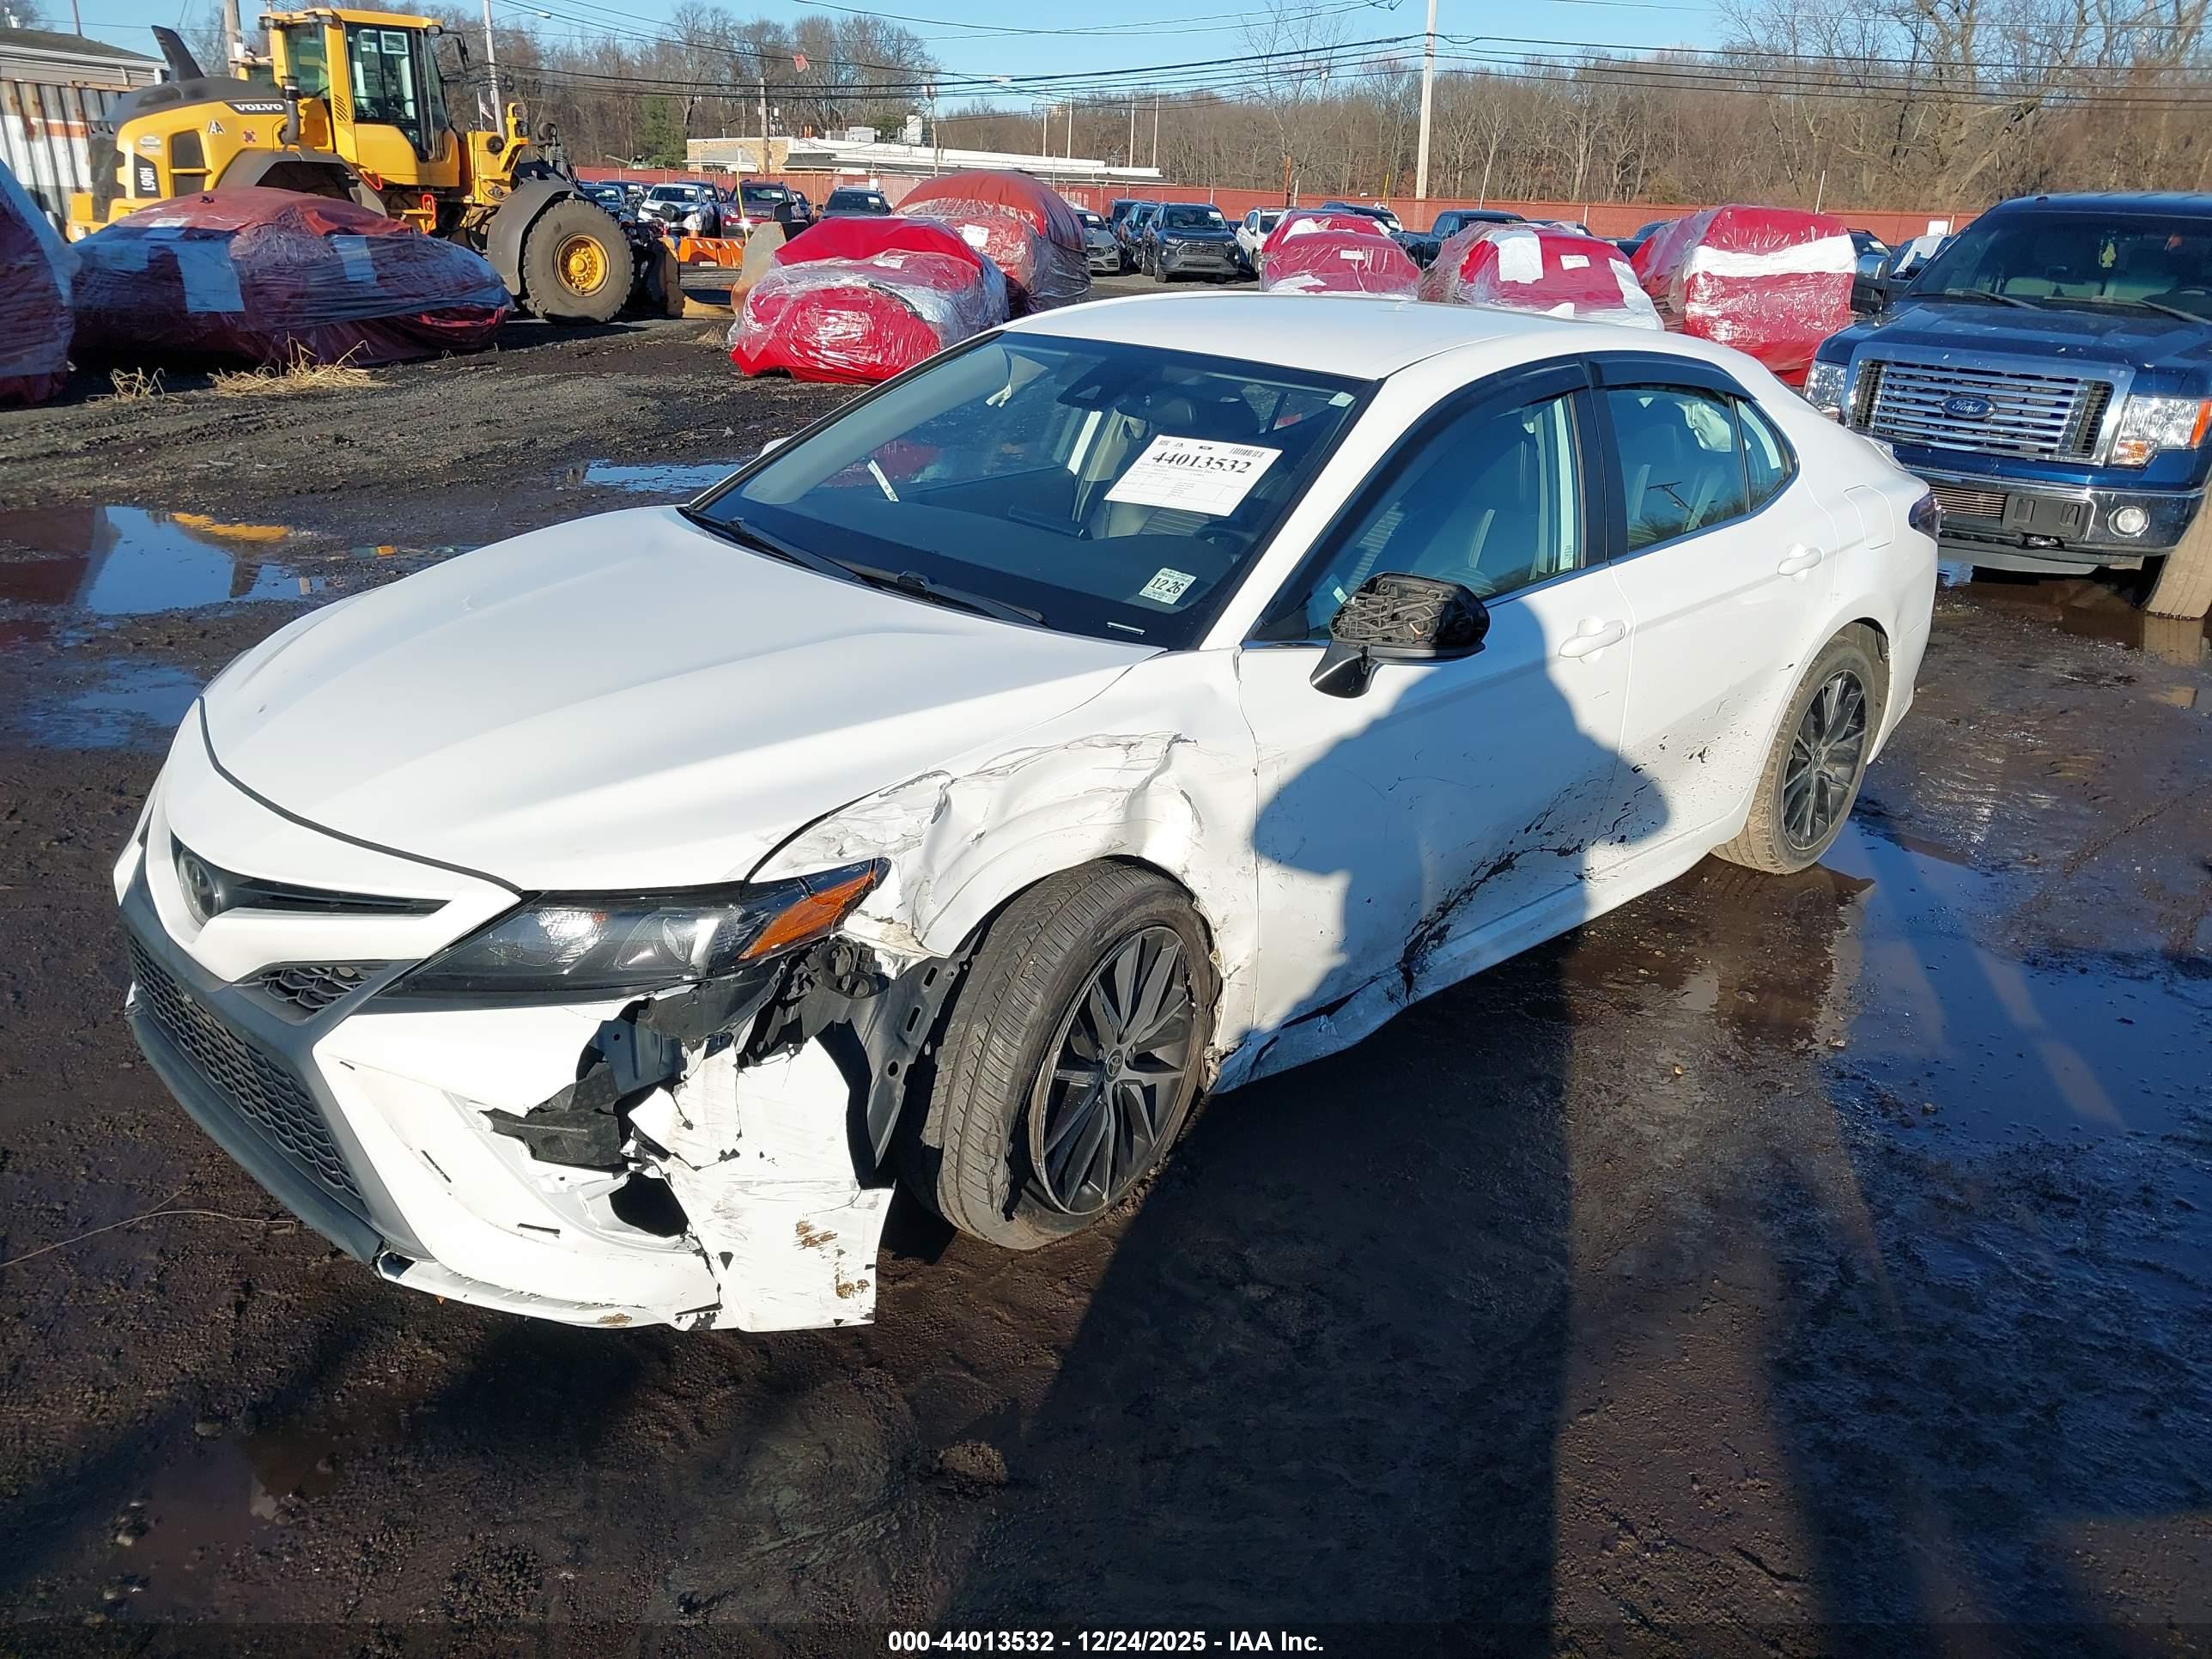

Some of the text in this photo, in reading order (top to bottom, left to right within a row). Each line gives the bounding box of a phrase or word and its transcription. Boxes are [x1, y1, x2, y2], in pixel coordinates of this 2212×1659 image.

[234, 103, 284, 112] VOLVO
[139, 167, 157, 191] L90H
[1952, 399, 1983, 413] Ford
[1152, 452, 1252, 473] 44013532
[1151, 577, 1184, 594] 12 26
